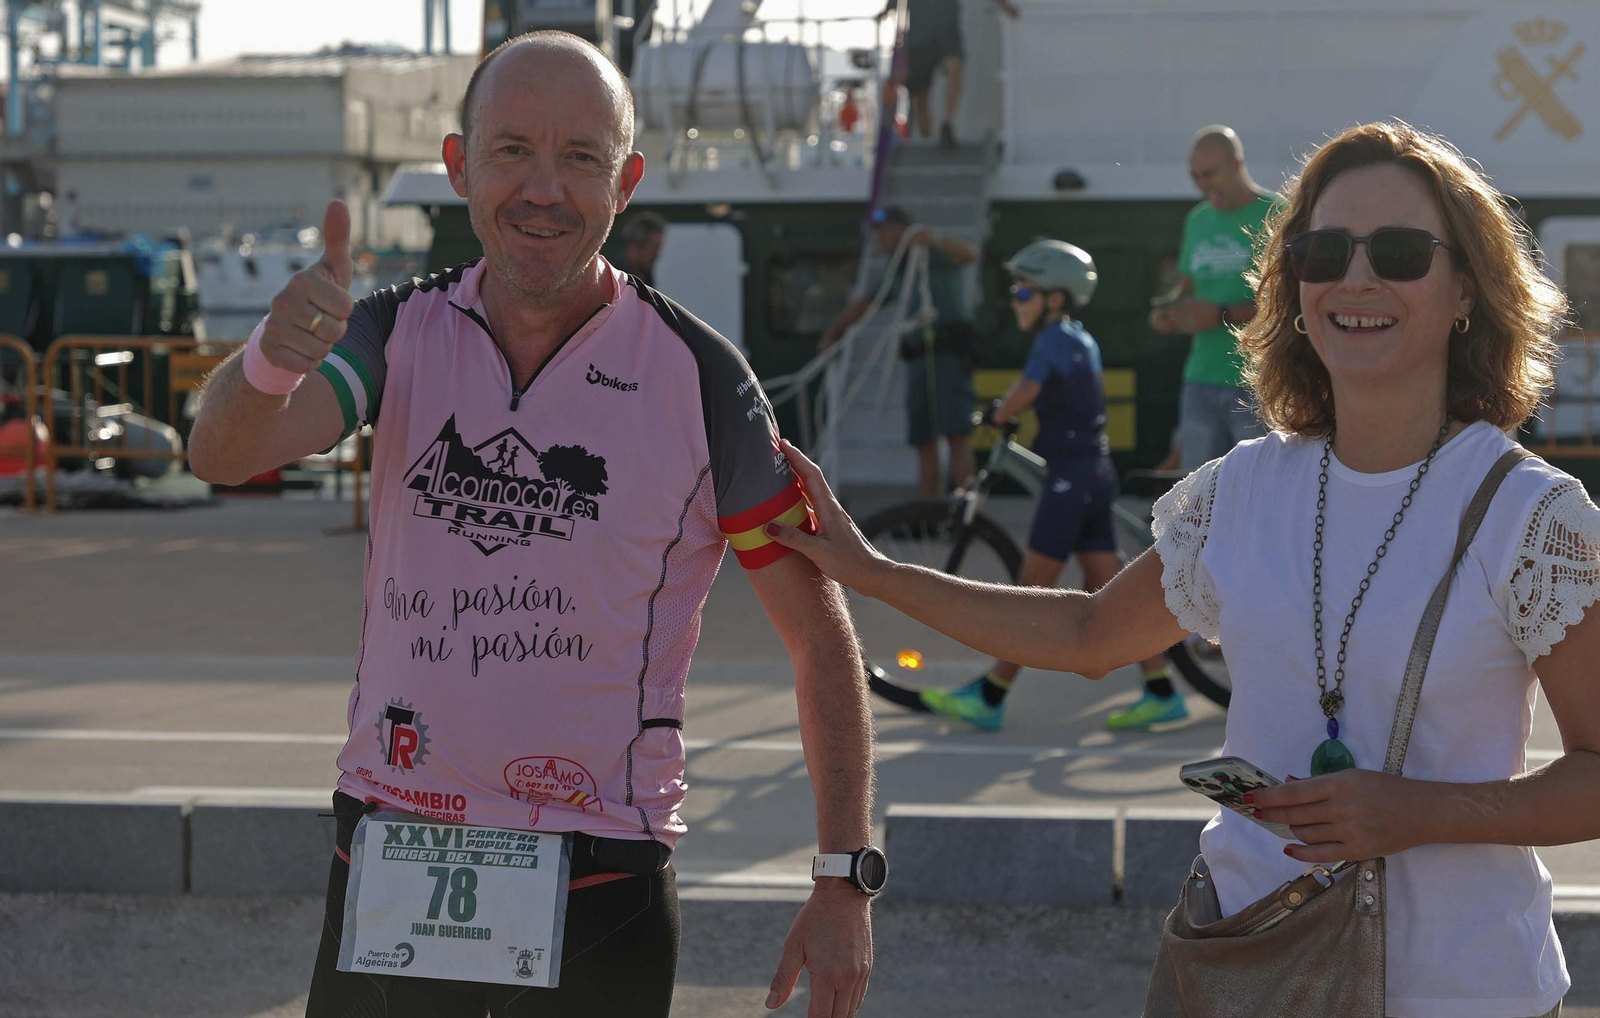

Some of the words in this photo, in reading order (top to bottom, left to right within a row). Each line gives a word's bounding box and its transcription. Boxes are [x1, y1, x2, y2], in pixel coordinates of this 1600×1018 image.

[423, 498, 567, 538] TRAIL
[447, 526, 531, 547] RUNNING
[453, 575, 577, 631] pasión,
[411, 625, 453, 662] mi
[471, 622, 593, 678] pasión
[355, 766, 373, 778] GRUPO
[515, 759, 584, 786] JOSAMO
[413, 807, 466, 822] ALGECIRAS
[383, 824, 463, 848] XXVI
[466, 829, 540, 843] CARRERA
[465, 840, 538, 853] POPULAR
[384, 847, 438, 861] VIRGEN
[446, 851, 474, 864] DEL
[481, 854, 534, 868] PILAR
[426, 866, 478, 922] 78
[410, 922, 435, 937] JUAN
[438, 925, 492, 941] GUERRERO
[355, 956, 398, 968] Algeciras
[368, 950, 390, 958] Puerto
